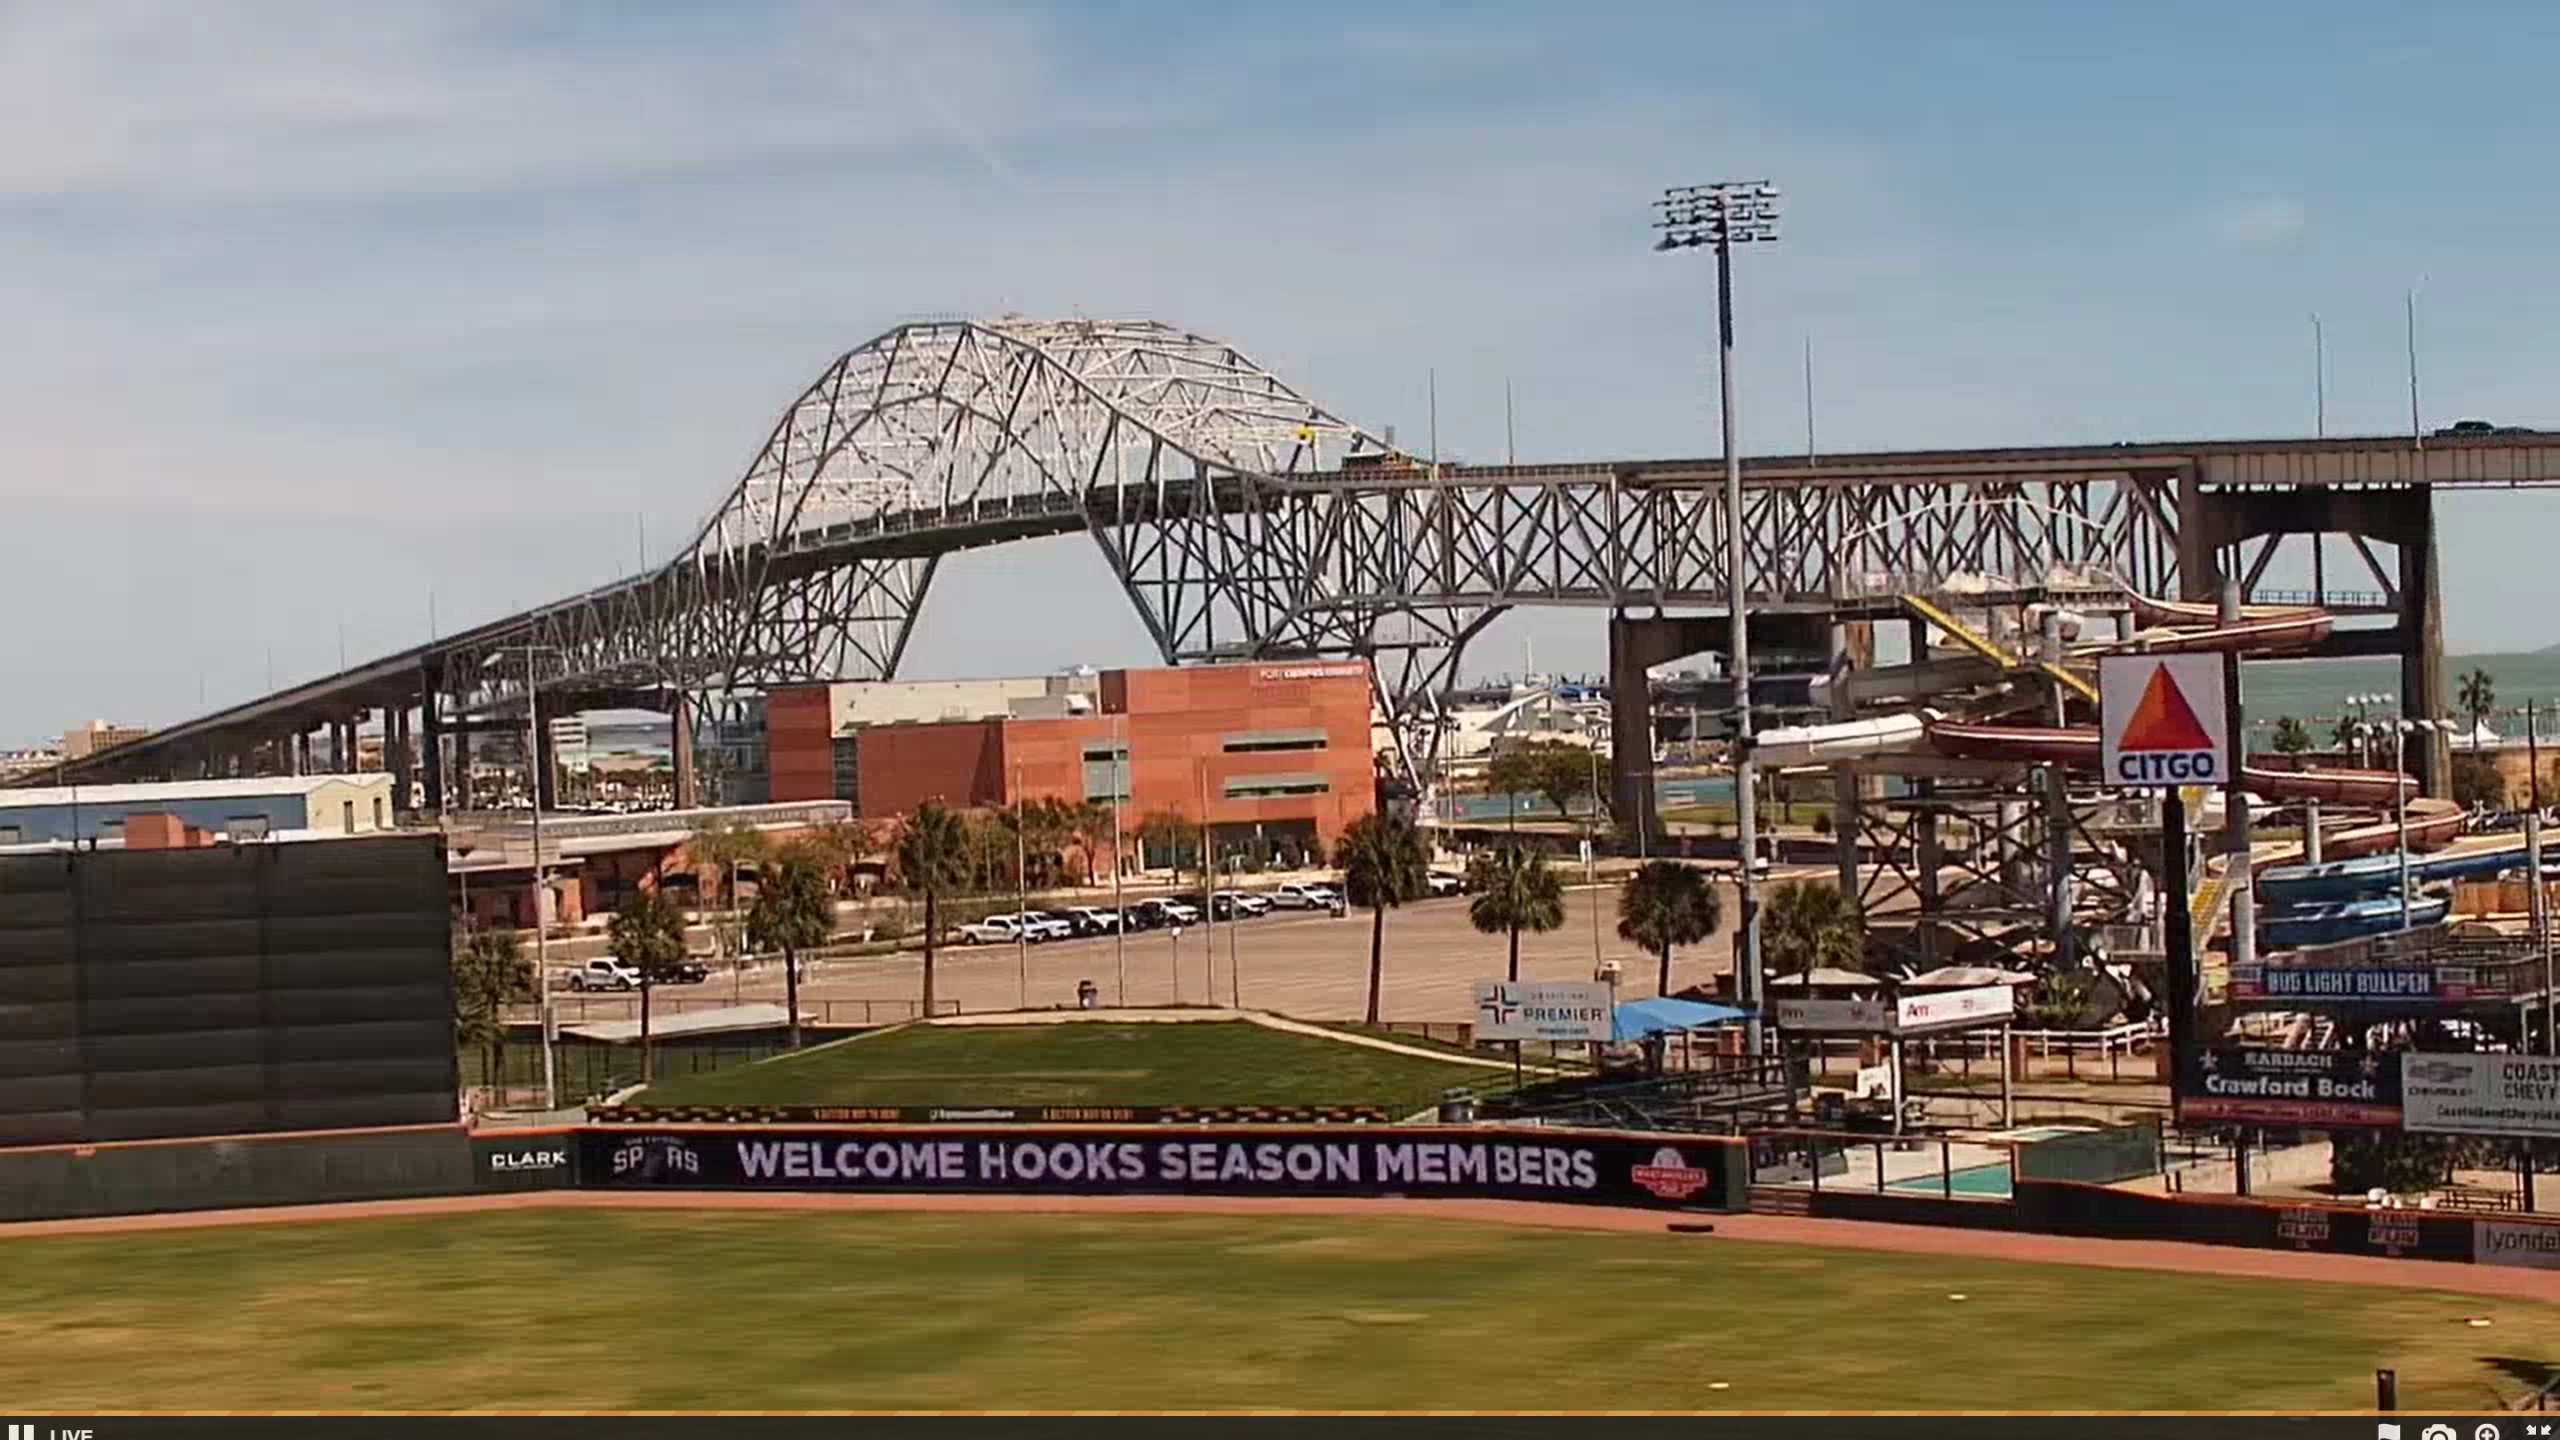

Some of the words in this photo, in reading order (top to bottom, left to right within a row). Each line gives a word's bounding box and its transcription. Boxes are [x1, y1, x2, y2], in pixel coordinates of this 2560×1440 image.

[2119, 752, 2214, 780] CITGO
[2268, 973, 2300, 992] BUD
[2305, 973, 2352, 993] LIGHT
[2357, 973, 2429, 993] BULLPEN
[1523, 1007, 1602, 1022] PREMIER
[2205, 1074, 2310, 1097] Crawford
[2318, 1078, 2376, 1099] Bock
[491, 1151, 567, 1167] CLARK
[613, 1145, 699, 1174] SPRS
[737, 1142, 967, 1178] WELCOME
[979, 1143, 1147, 1180] HOOKS
[1159, 1143, 1360, 1181] SEASON
[1376, 1143, 1598, 1189] MEMBERS
